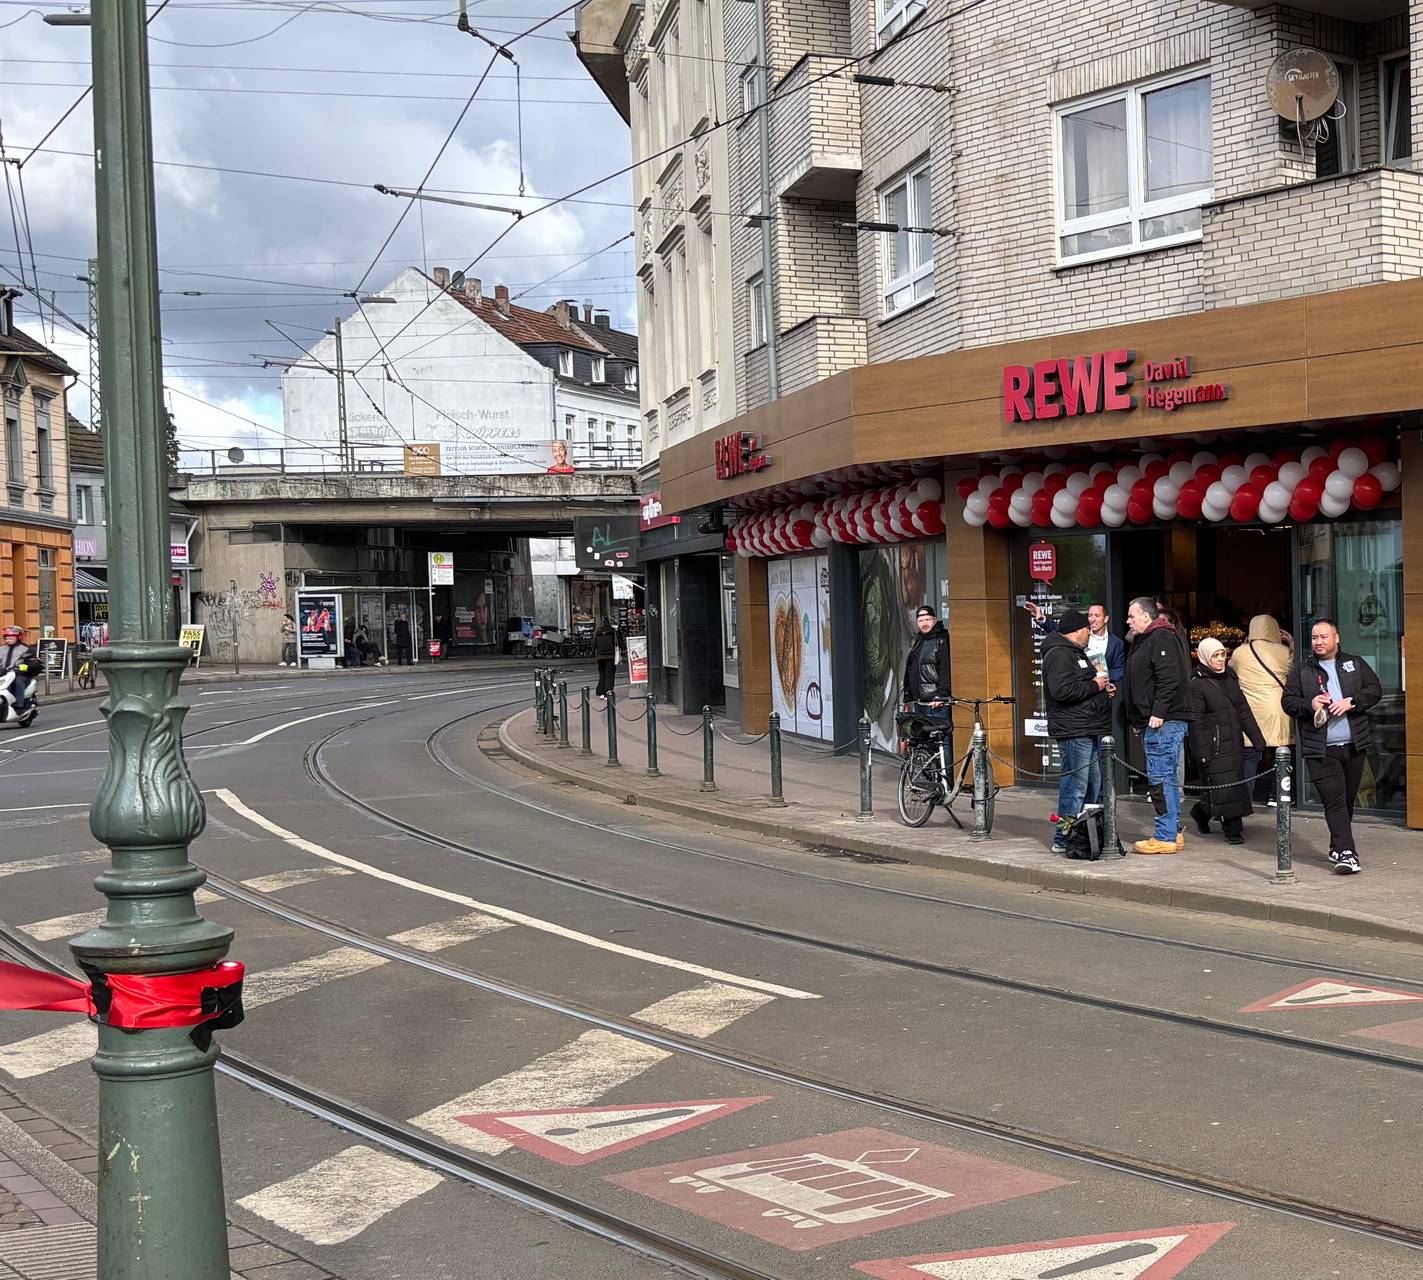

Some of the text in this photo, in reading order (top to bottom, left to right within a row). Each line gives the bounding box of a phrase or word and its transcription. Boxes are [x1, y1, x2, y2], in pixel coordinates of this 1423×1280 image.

[1144, 356, 1191, 382] David
[1003, 349, 1135, 423] REWE
[1145, 382, 1228, 412] Hegemann
[715, 432, 748, 480] REWE
[75, 540, 97, 557] HION
[1033, 550, 1052, 560] REWE
